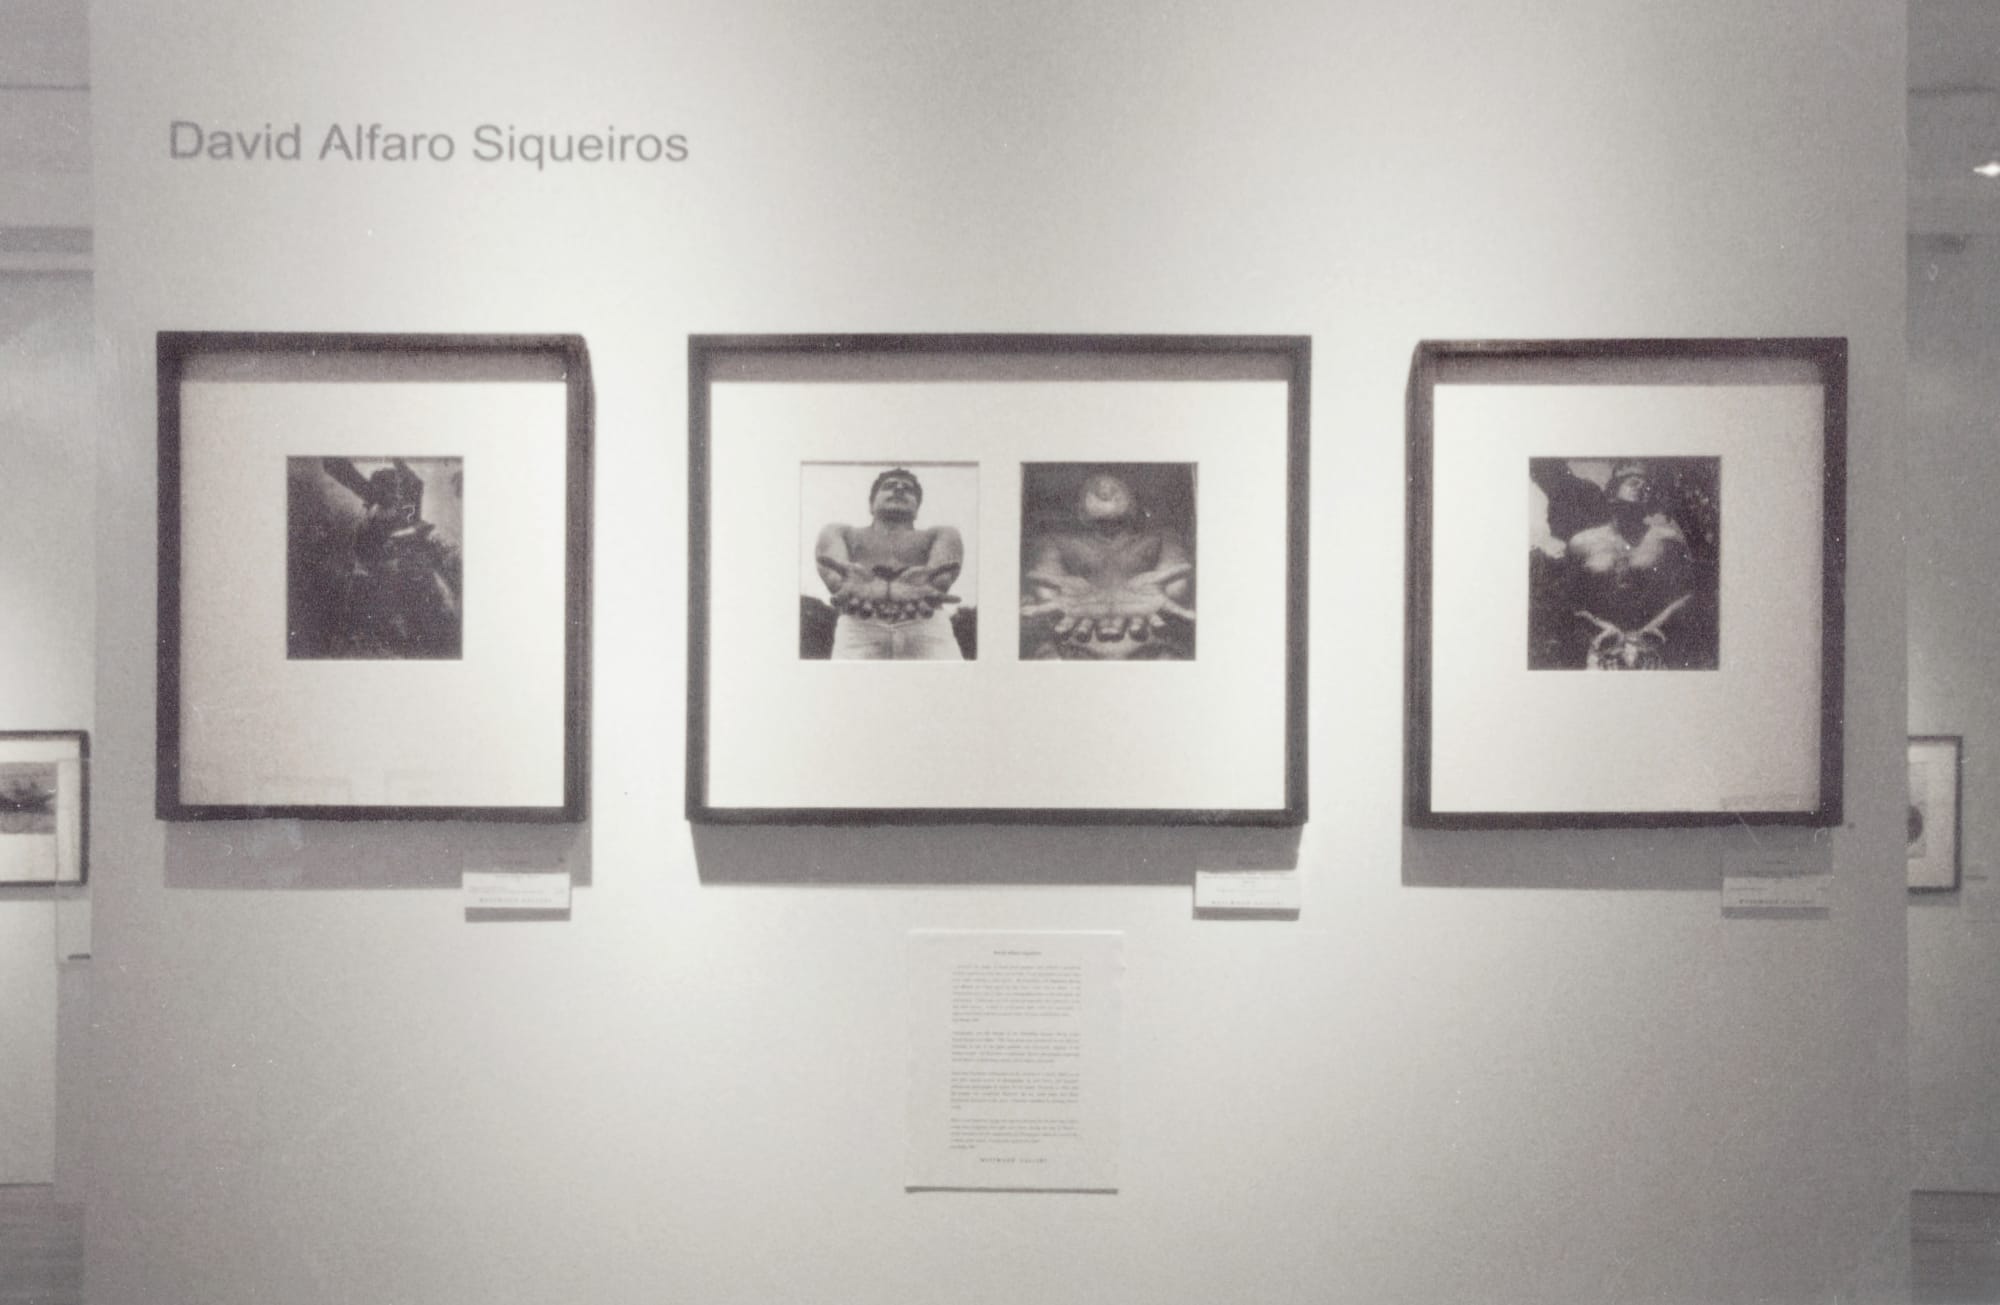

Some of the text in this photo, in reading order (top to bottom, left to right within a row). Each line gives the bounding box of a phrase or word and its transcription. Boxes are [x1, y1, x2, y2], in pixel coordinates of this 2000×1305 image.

[169, 120, 689, 171] David Alfaro Siqueiros
